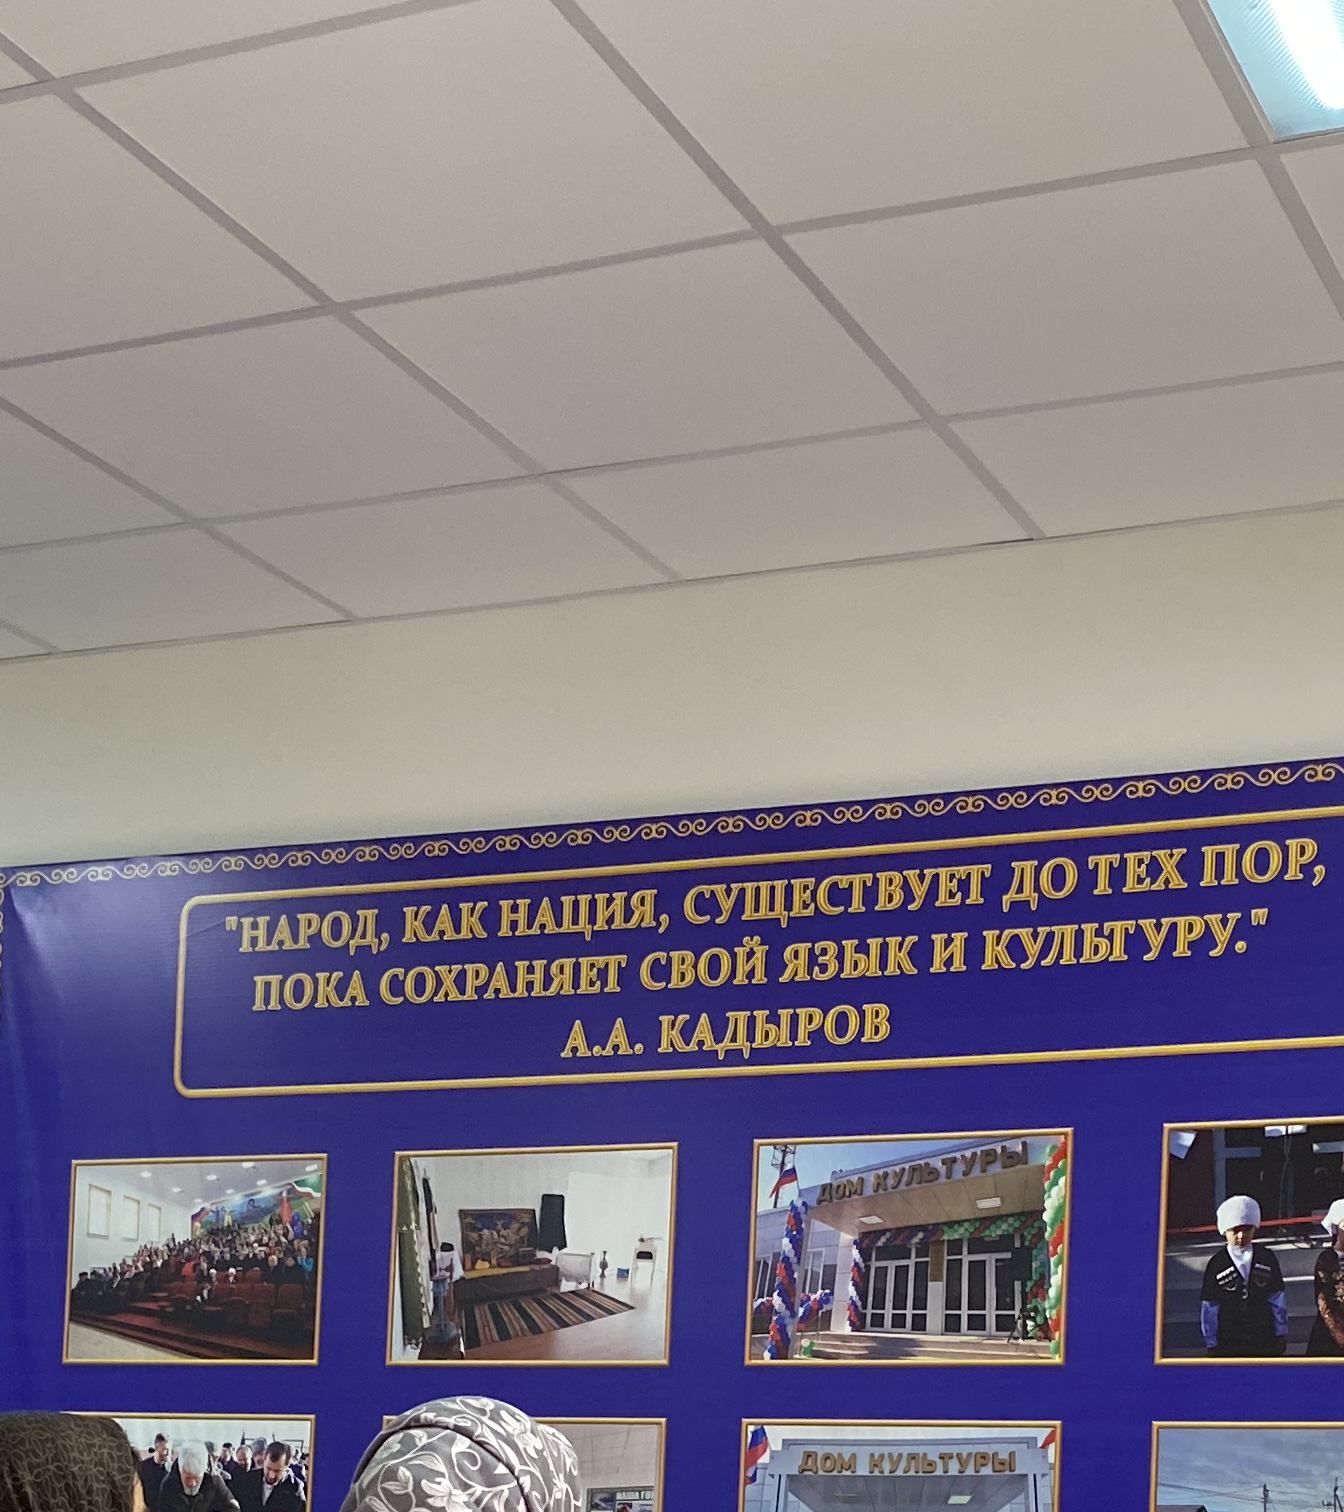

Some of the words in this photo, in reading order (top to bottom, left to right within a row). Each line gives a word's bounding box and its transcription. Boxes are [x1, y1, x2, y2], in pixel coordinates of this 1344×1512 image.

[225, 908, 390, 955] "НАРОД,
[402, 902, 486, 943] КАК
[498, 889, 670, 940] НАЦИЯ,
[683, 863, 991, 927] СУЩЕСТВУЕТ
[1002, 857, 1077, 911] ДО
[1088, 848, 1187, 895] ТЕХ
[1200, 837, 1326, 888] ПОР,
[252, 970, 369, 1011] ПОКА
[379, 954, 627, 1004] СОХРАНЯЕТ
[640, 936, 768, 990] СВОЙ
[779, 935, 918, 983] ЯЗЫК
[931, 931, 966, 971] И
[981, 907, 1268, 971] КУЛЬТУРУ."
[560, 1016, 644, 1058] А.А.
[658, 1003, 891, 1059] КАДЫРОВ
[816, 1176, 864, 1205] ДОМ
[872, 1141, 1030, 1193] КУЛЬТУРЫ
[798, 1451, 856, 1474] ДОМ
[868, 1450, 1016, 1474] КУЛЬТУРЫ
